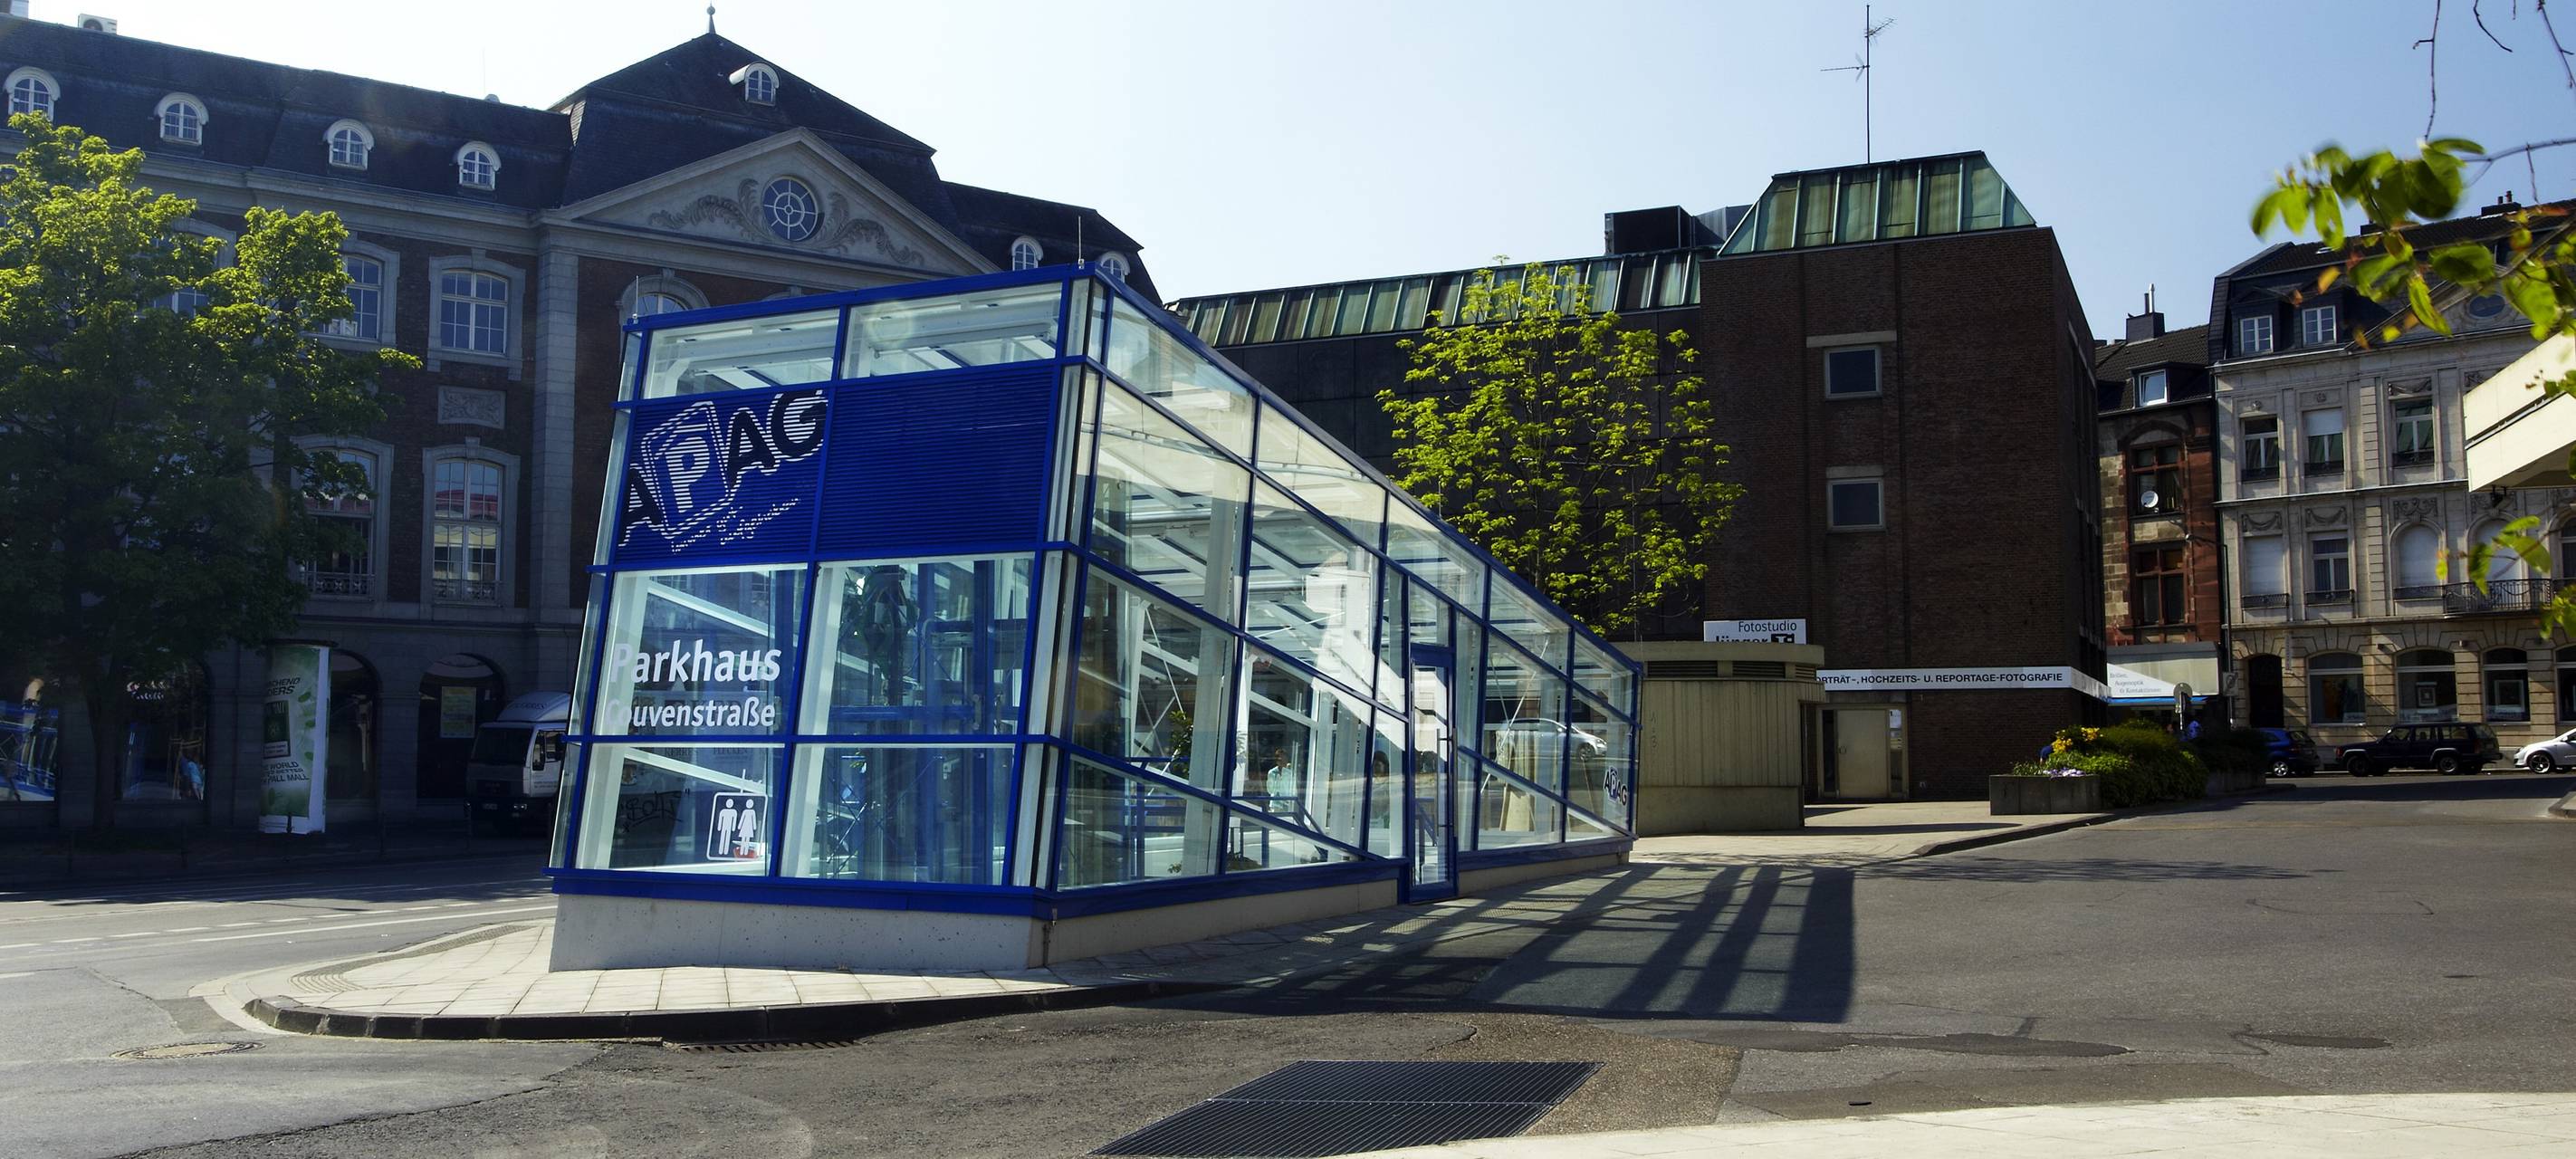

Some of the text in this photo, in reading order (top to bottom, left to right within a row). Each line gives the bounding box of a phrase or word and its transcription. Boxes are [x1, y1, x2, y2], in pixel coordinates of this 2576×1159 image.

[618, 389, 828, 547] APAG
[1738, 621, 1797, 632] Fotostudio
[610, 639, 781, 683] Parkhaus
[1816, 673, 2064, 685] ORTRÄT-, HOCHZEITS- U. REPORTAGE-FOTOGRAFIE
[604, 696, 776, 727] Couvenstraße
[1603, 766, 1628, 806] APAG
